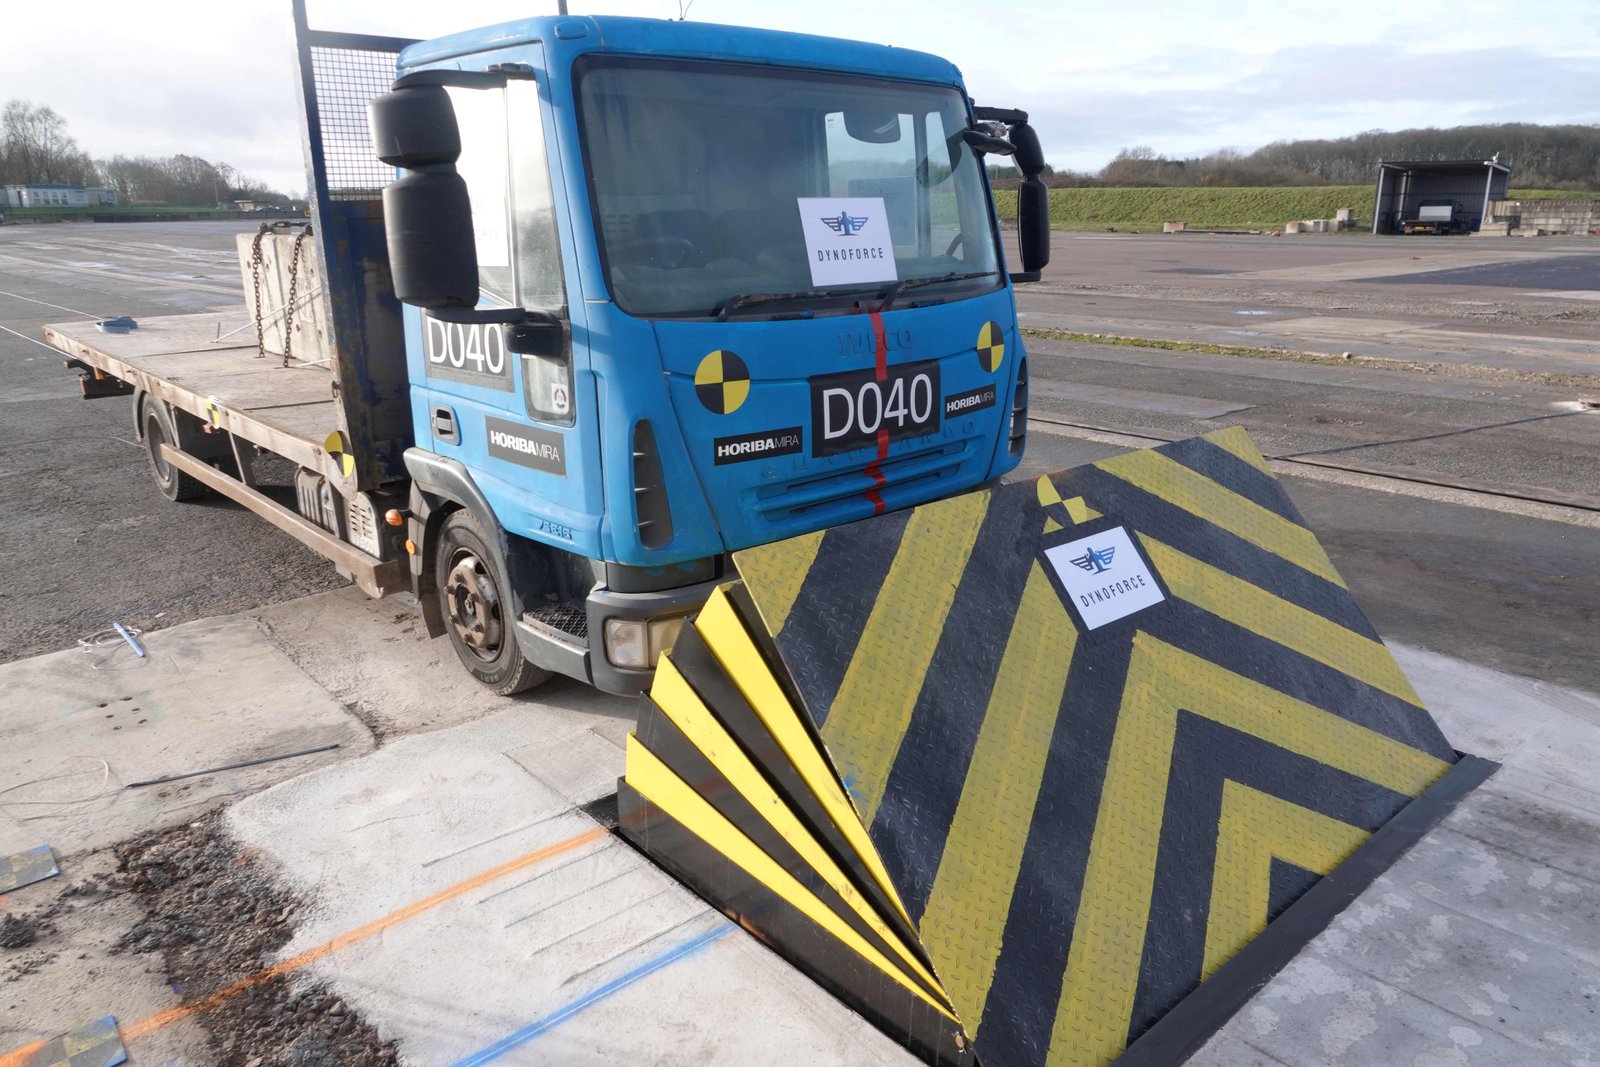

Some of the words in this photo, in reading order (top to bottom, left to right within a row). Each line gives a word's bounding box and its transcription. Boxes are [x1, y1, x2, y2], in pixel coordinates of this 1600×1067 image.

[818, 248, 884, 261] DYNOFORCE
[427, 316, 504, 373] D040
[823, 373, 932, 440] D040
[1080, 575, 1146, 607] DYNOFORCE
